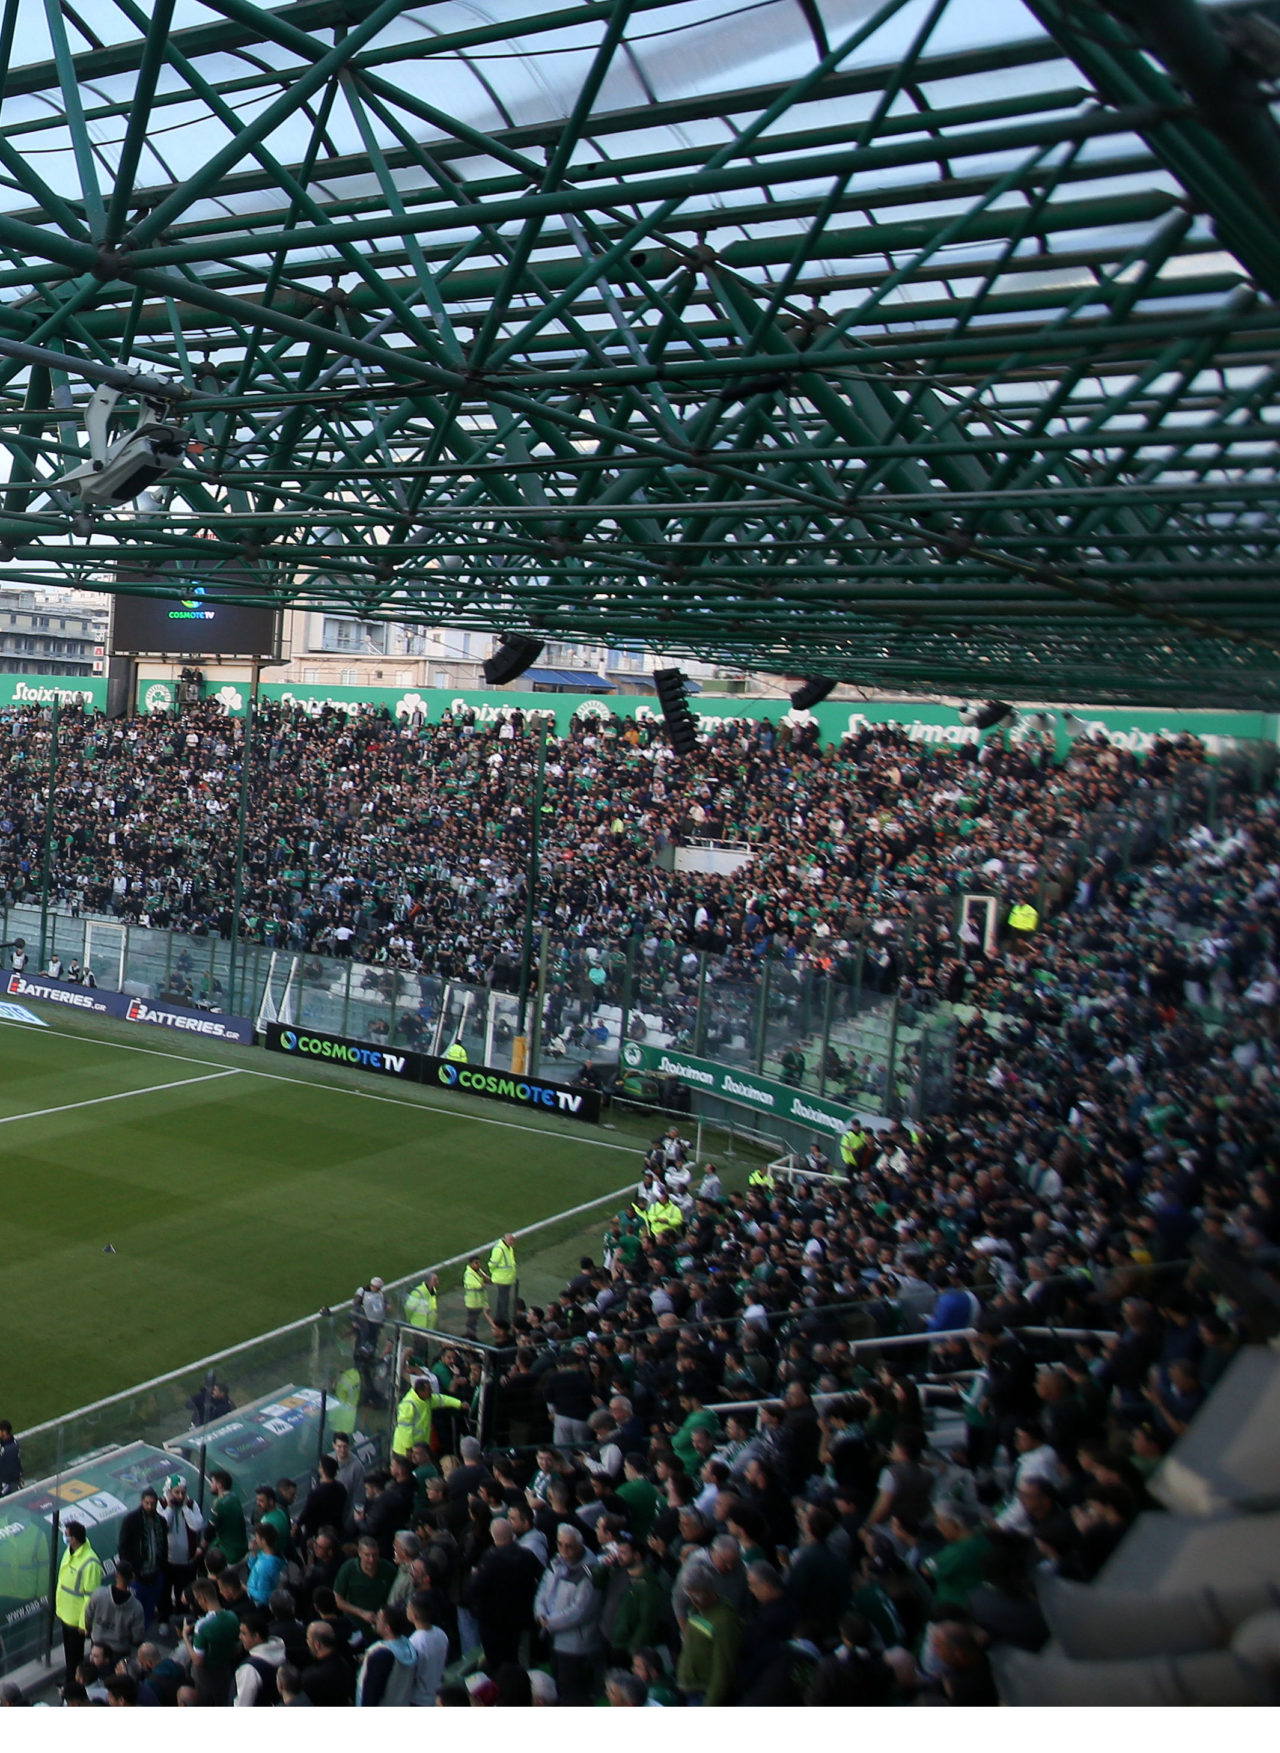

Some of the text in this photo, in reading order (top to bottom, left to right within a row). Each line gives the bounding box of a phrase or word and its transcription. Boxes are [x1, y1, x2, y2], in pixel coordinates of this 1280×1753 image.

[17, 979, 107, 1012] BATTERIES.GR
[138, 1004, 240, 1040] BATTERIES.GR
[297, 1035, 406, 1074] COSMOTE TV
[458, 1070, 583, 1113] COSMOTE TV
